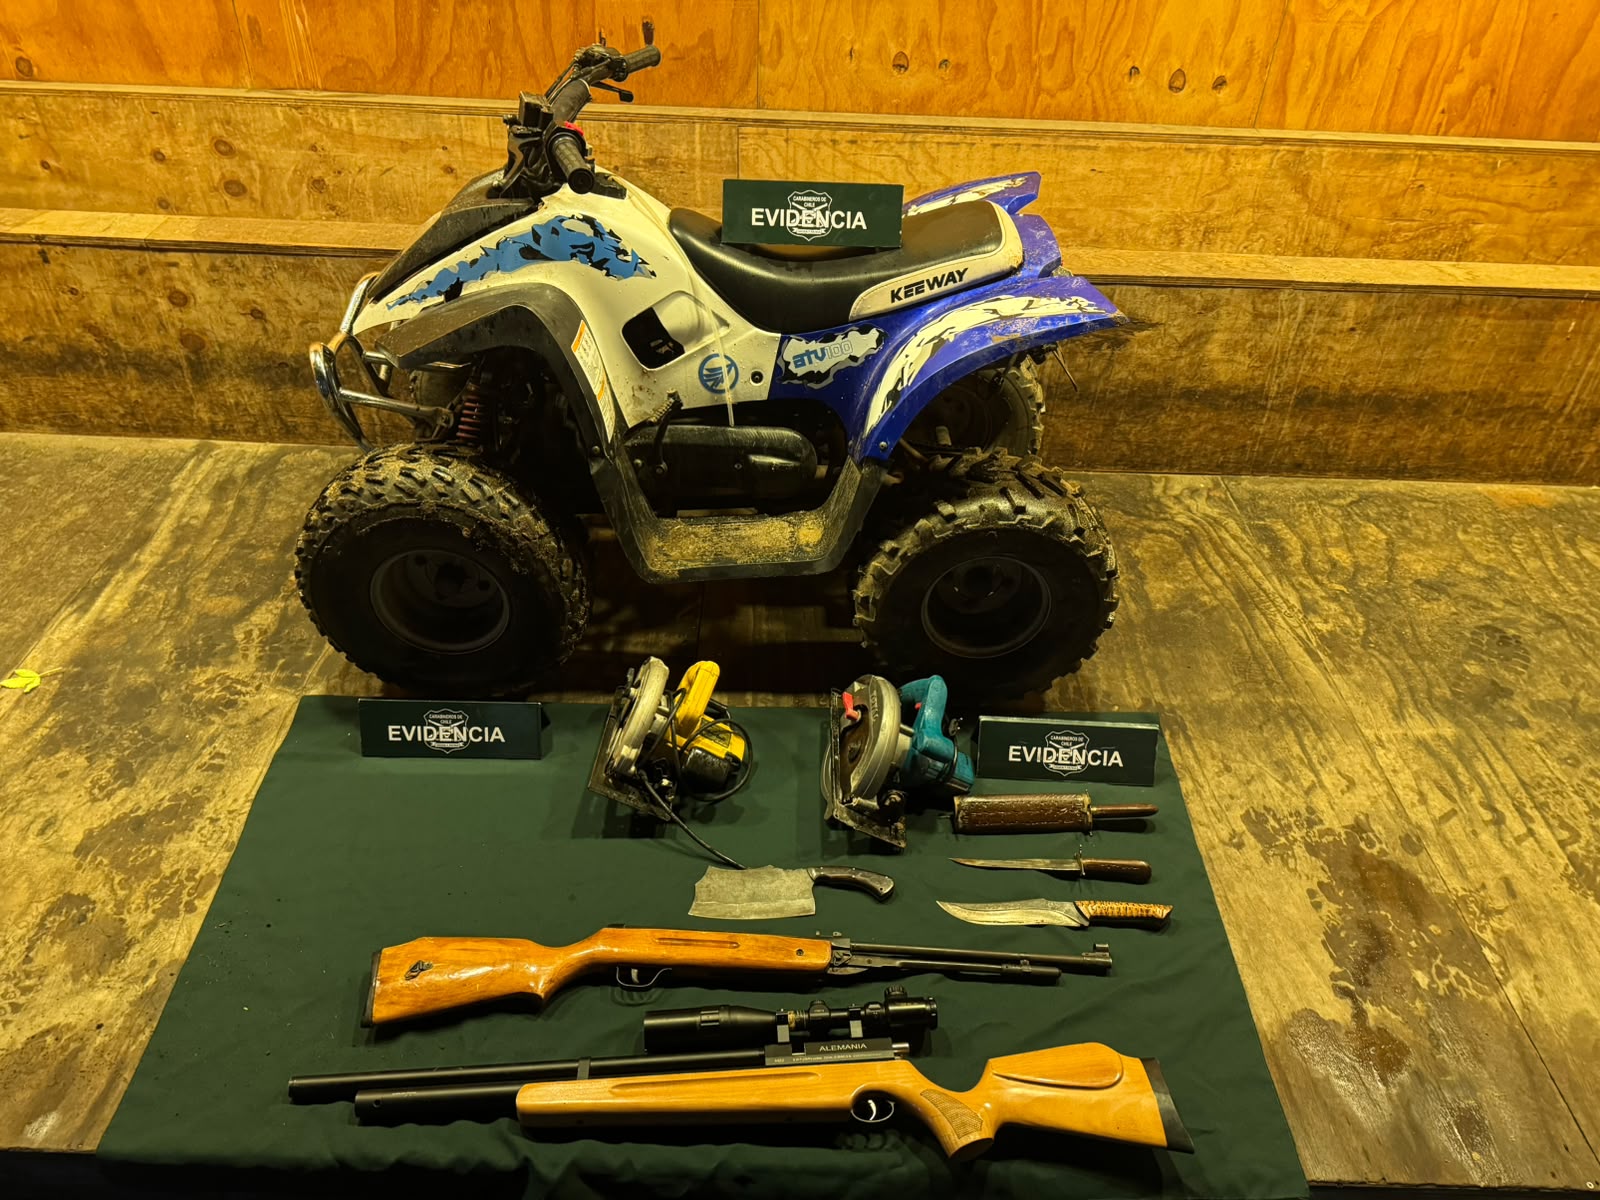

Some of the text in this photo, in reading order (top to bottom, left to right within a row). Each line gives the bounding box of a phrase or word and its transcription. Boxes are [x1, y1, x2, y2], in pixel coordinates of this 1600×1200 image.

[751, 208, 867, 230] EVIDENCIA
[890, 267, 968, 303] KEEWAY
[388, 725, 505, 743] EVIDENCIA
[1008, 745, 1123, 767] EVIDENCIA
[819, 1043, 867, 1052] ALEMANIA
